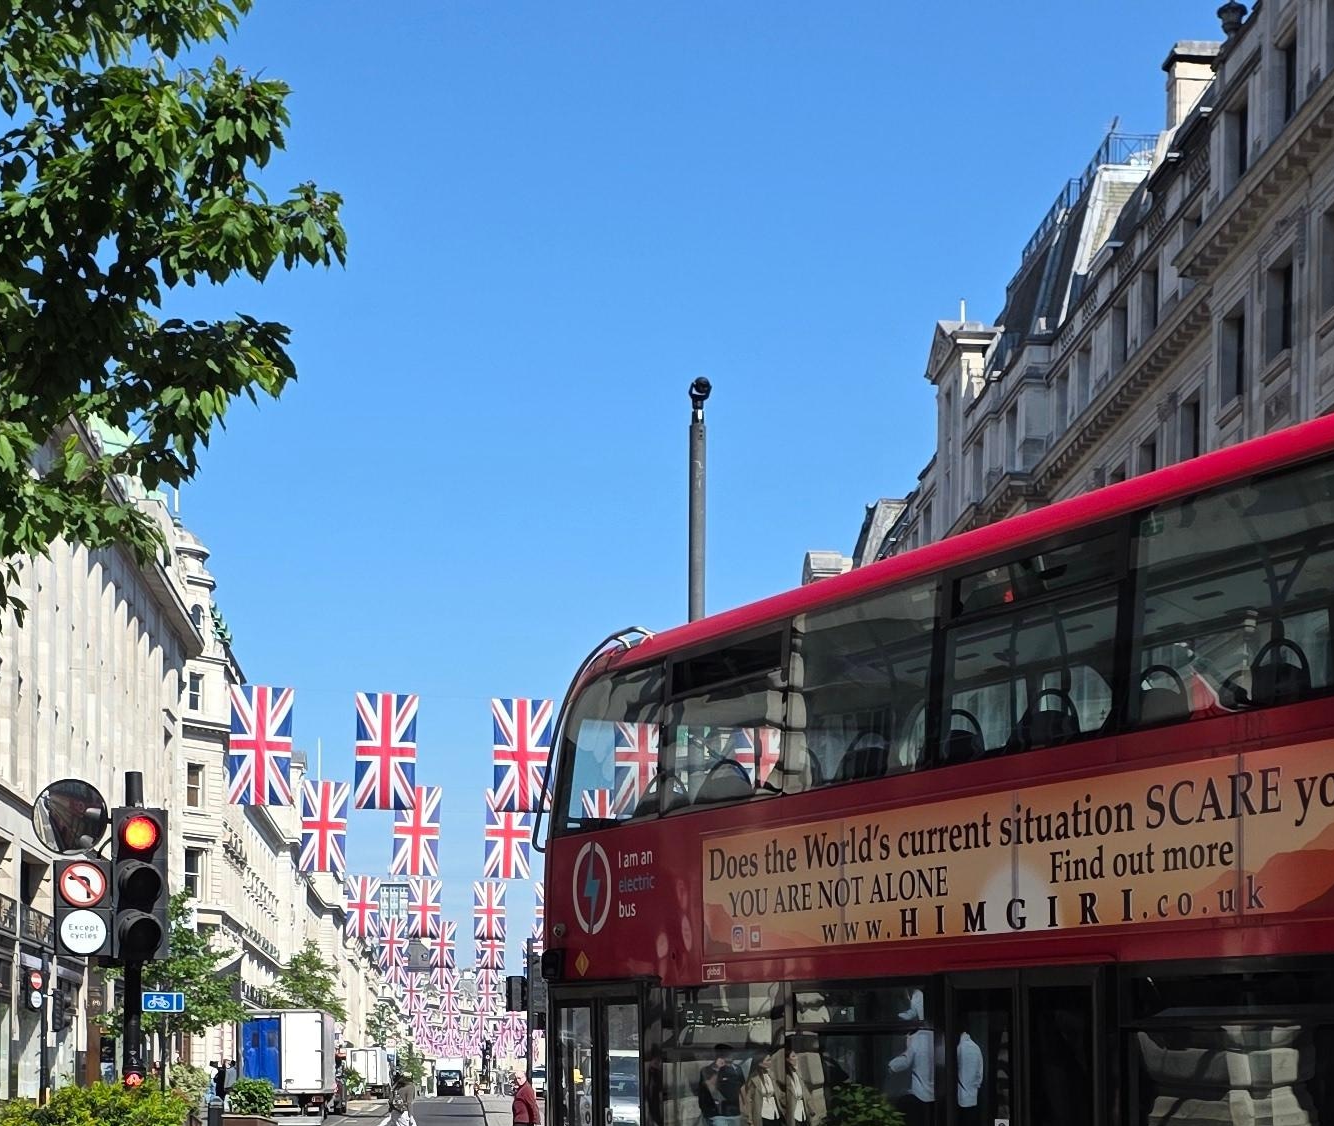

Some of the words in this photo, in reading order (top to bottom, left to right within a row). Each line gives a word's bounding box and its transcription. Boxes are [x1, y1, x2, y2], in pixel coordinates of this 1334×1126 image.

[709, 847, 759, 881] Does
[765, 838, 797, 875] the
[803, 823, 891, 870] World's
[898, 811, 992, 859] current
[999, 793, 1135, 846] situation
[1146, 766, 1282, 831] SCARE
[623, 853, 640, 869] am
[641, 852, 653, 867] an
[1050, 844, 1105, 885] Find
[1112, 841, 1155, 878] out
[1162, 838, 1234, 872] more
[618, 874, 656, 894] electric
[728, 888, 769, 919] YOU
[773, 882, 813, 914] ARE
[818, 875, 864, 909] NOT
[869, 865, 949, 905] ALONE
[618, 900, 637, 919] bus
[68, 923, 100, 933] Except
[70, 932, 98, 940] cycles
